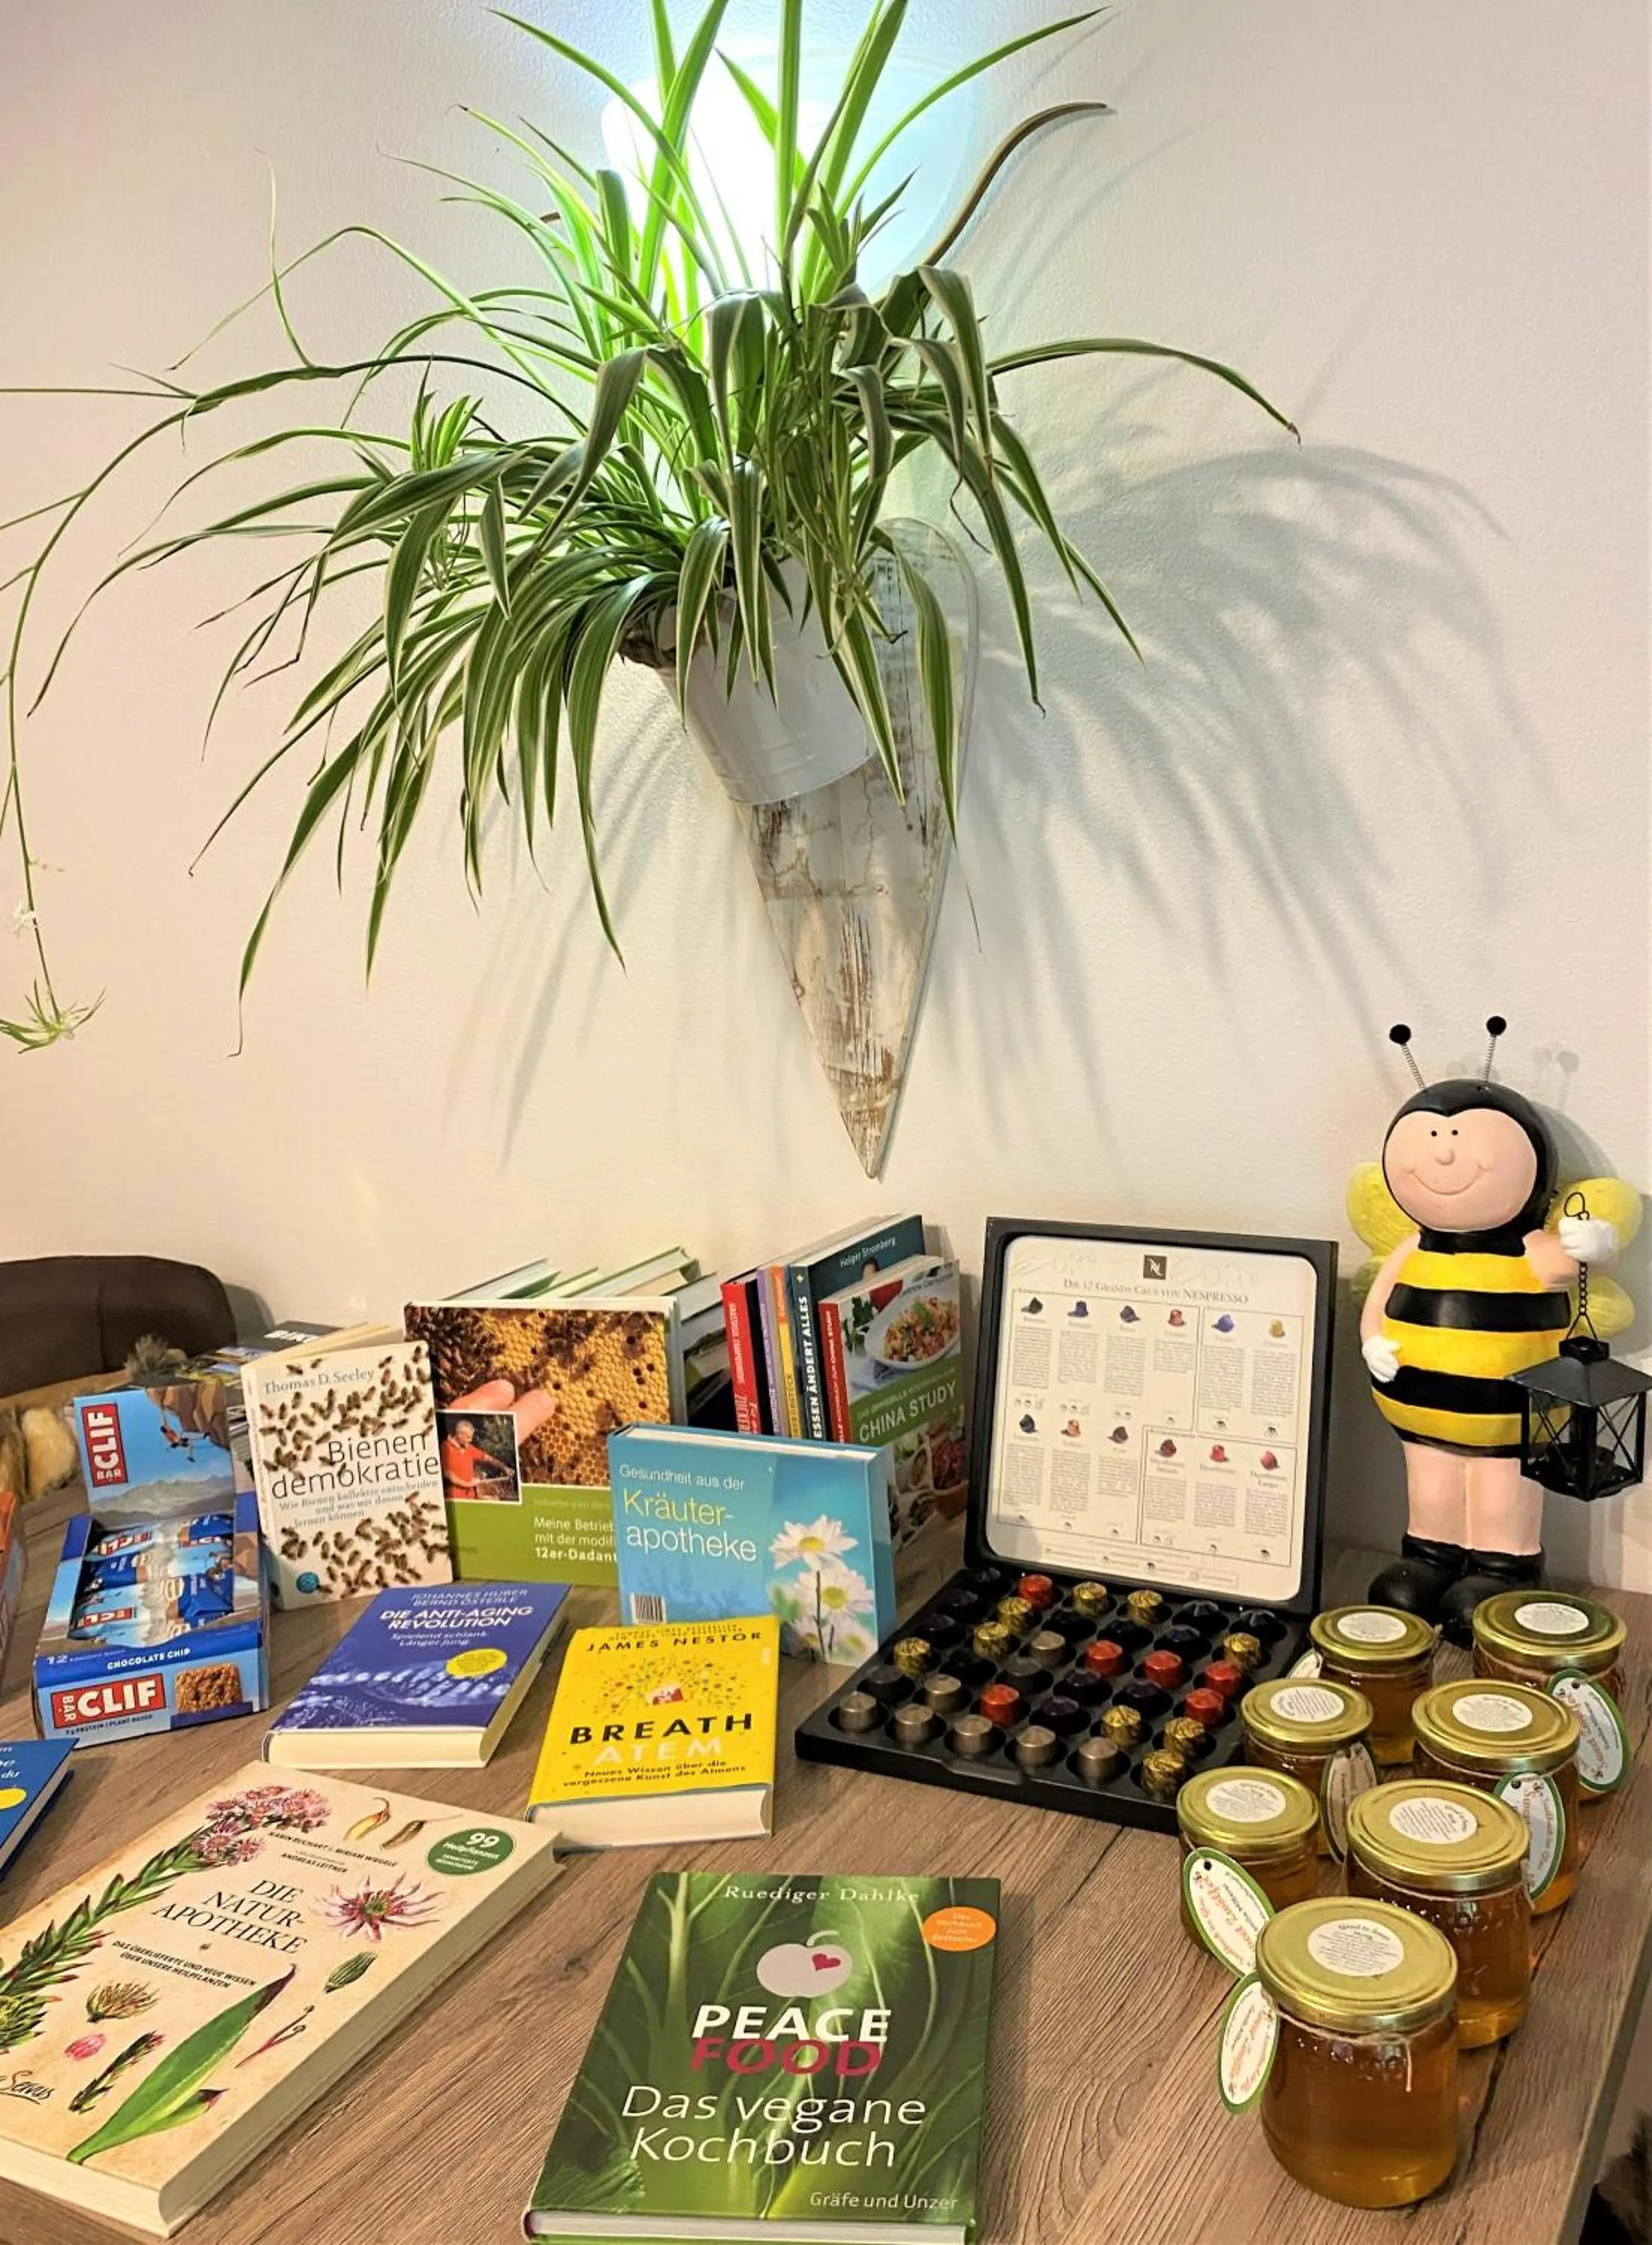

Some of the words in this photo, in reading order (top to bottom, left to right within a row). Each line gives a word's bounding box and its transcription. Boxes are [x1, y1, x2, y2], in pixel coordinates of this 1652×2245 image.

[839, 1252, 861, 1268] Holger
[861, 1236, 896, 1258] Stromberg
[798, 1296, 813, 1338] ALLES
[266, 1375, 315, 1395] Thomas
[333, 1368, 374, 1384] Seeley
[802, 1340, 819, 1394] ÄNDERT
[809, 1396, 823, 1439] ESSEN
[860, 1407, 905, 1444] CHINA
[910, 1380, 956, 1418] STUDY
[88, 1410, 120, 1470] CLIF
[328, 1432, 426, 1463] Bienen
[97, 1468, 122, 1481] BAR
[272, 1453, 440, 1500] demokratie
[619, 1464, 692, 1485] Gesundheit
[696, 1475, 719, 1488] aus
[723, 1476, 745, 1491] der
[302, 1495, 335, 1507] Bienen
[623, 1487, 735, 1527] Kräuter-
[533, 1517, 571, 1530] Meine
[535, 1533, 555, 1545] mit
[557, 1533, 576, 1546] der
[626, 1525, 757, 1563] apotheke
[412, 1590, 481, 1600] JOHANNES
[482, 1589, 527, 1598] HUBER
[379, 1610, 412, 1620] DIE
[414, 1606, 534, 1619] ANTI-AGING
[388, 1616, 513, 1630] REVOLUTION
[587, 1640, 659, 1652] JAMES
[673, 1631, 762, 1646] NESTOR
[47, 1655, 68, 1665] 12
[107, 1652, 165, 1670] CHOCOLATE
[167, 1646, 192, 1660] CHIP
[62, 1694, 76, 1722] BAR
[77, 1680, 156, 1717] CLIF
[570, 1713, 752, 1744] BREATH
[593, 1736, 723, 1766] ATEM
[563, 1774, 632, 1786] vergessene
[636, 1771, 671, 1781] Kunst
[675, 1768, 699, 1778] des
[701, 1765, 747, 1775] Atmens
[584, 1768, 622, 1778] Neues
[627, 1765, 671, 1774] Wissen
[675, 1761, 703, 1771] über
[707, 1759, 727, 1768] die
[466, 1833, 500, 1848] 99
[281, 1852, 320, 1867] ANDREAS
[316, 1861, 348, 1873] LEITNER
[249, 1879, 304, 1903] DIE
[723, 1884, 830, 1905] Ruediger
[838, 1887, 920, 1904] Dahlke
[204, 1890, 306, 1928] NATUR-
[151, 1902, 308, 1955] APOTHEKE
[112, 1940, 131, 1950] DAS
[129, 1943, 185, 1970] ÜBERLIEFERTE
[183, 1960, 201, 1973] UND
[200, 1964, 226, 1979] NEUE
[223, 1972, 257, 1987] WISSEN
[119, 1950, 143, 1964] ÜBER
[140, 1956, 173, 1974] UNSERE
[171, 1967, 230, 1988] HEILPFLANZEN
[691, 2004, 890, 2043] PEACE
[689, 2038, 883, 2077] FOOD
[621, 2086, 718, 2119] Das
[735, 2095, 926, 2134] vegane
[631, 2126, 896, 2168] Kochbuch
[810, 2190, 860, 2209] Gräfe
[863, 2193, 899, 2208] und
[902, 2193, 958, 2211] Unzer
